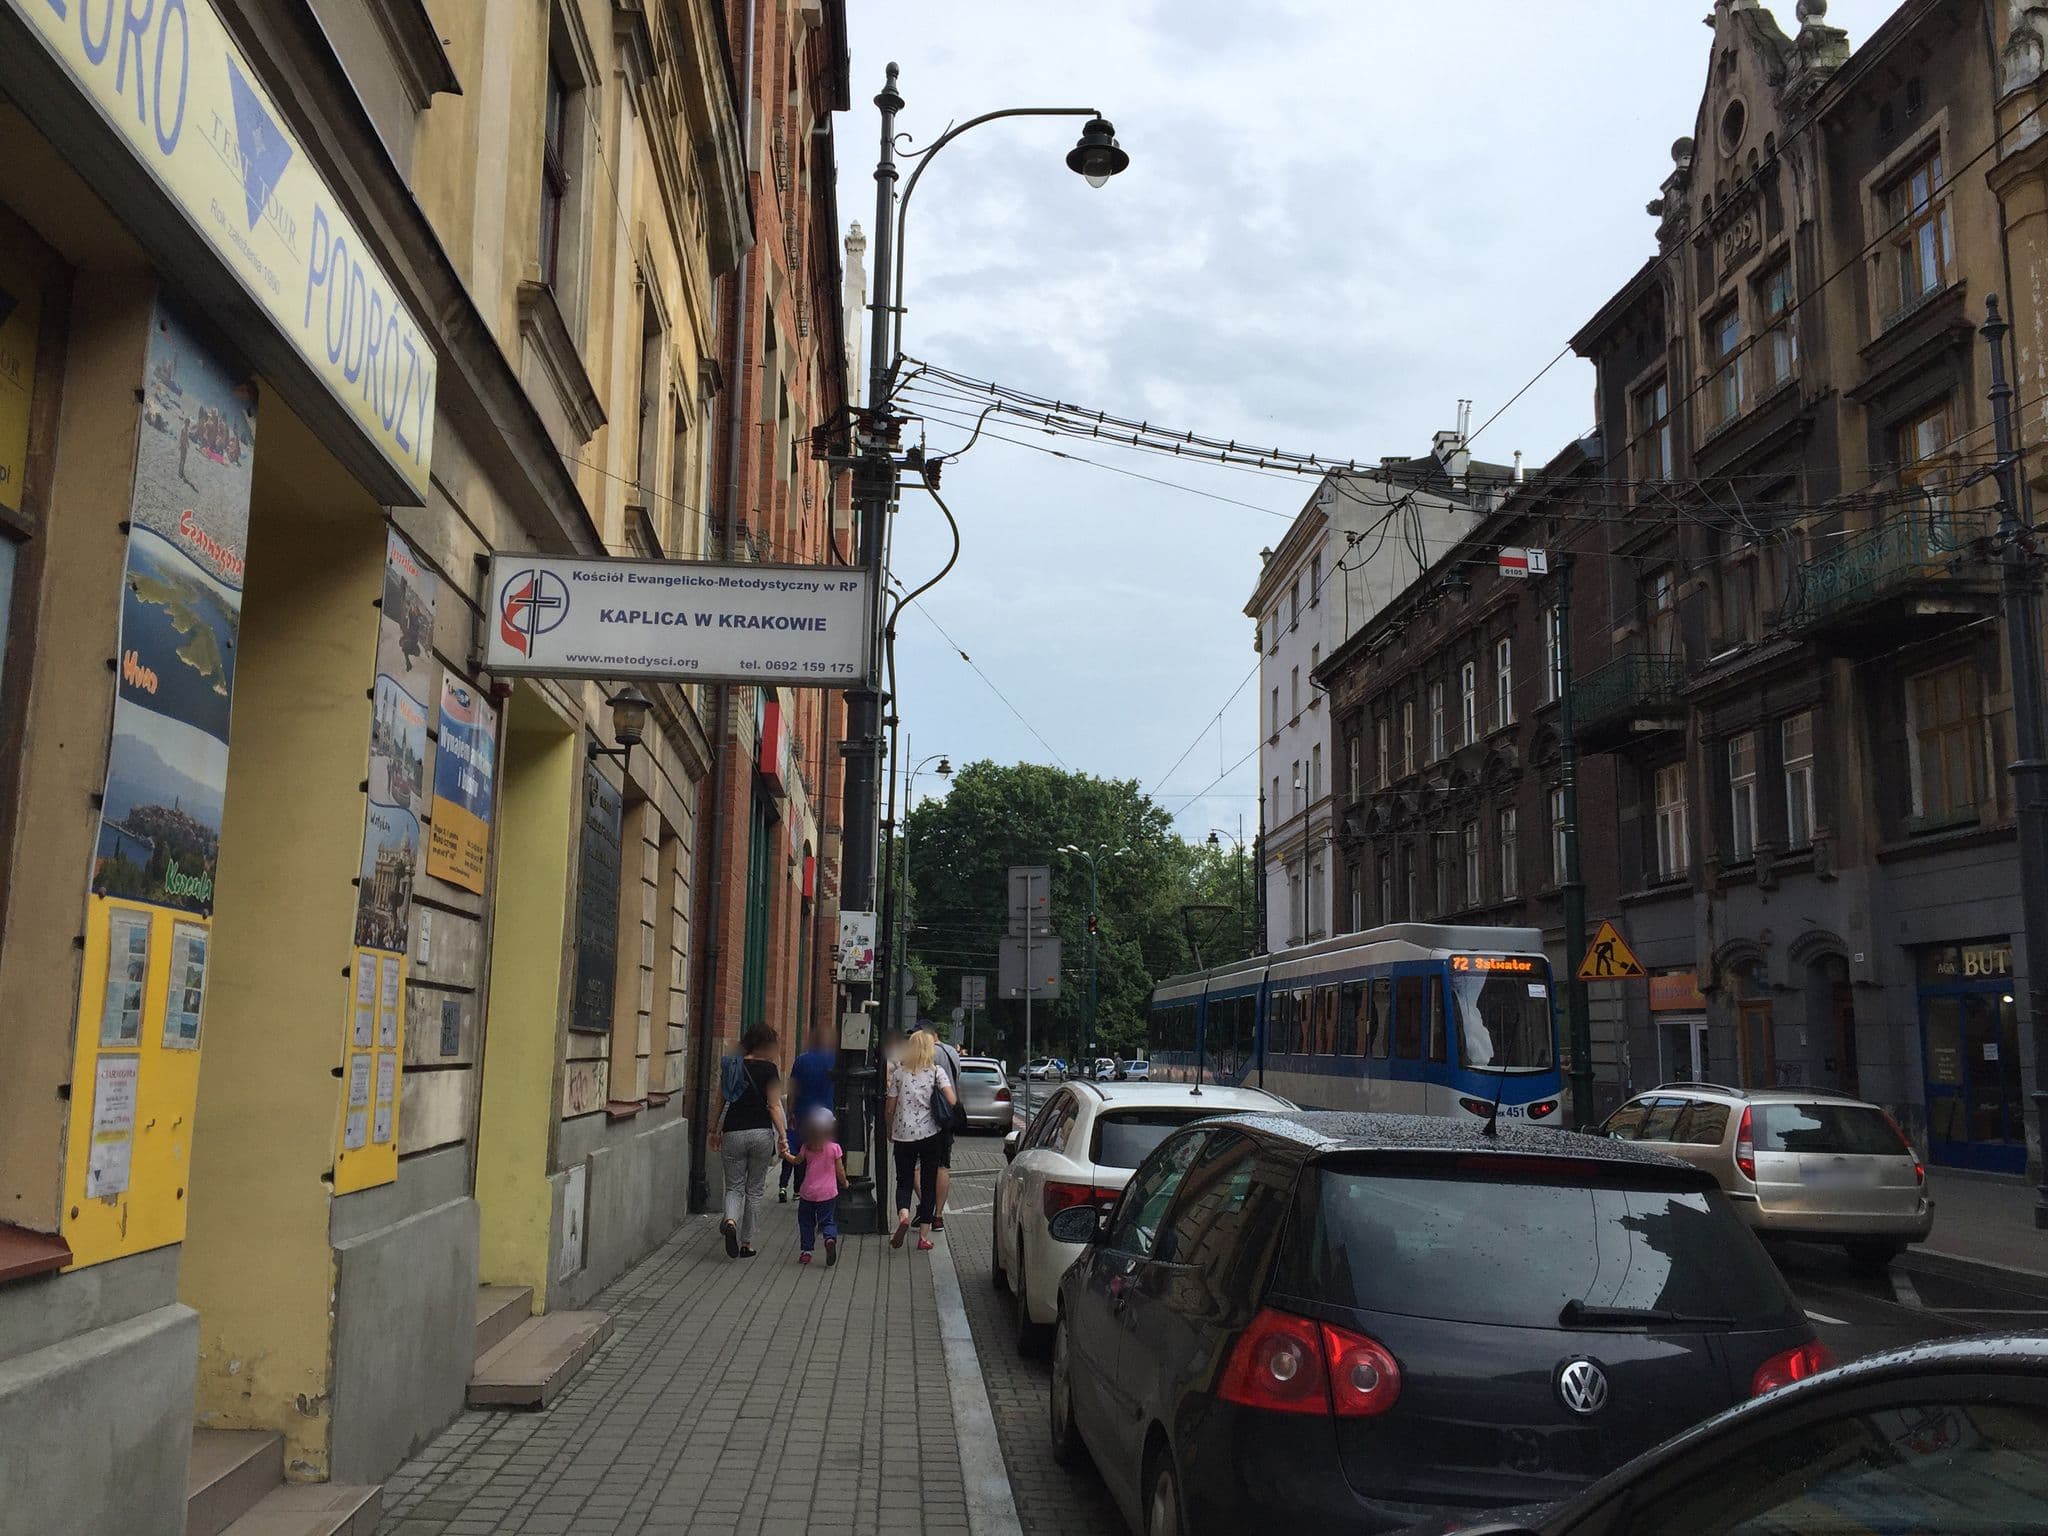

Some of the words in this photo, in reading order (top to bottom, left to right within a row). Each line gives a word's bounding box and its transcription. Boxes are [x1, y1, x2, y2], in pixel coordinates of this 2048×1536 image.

[46, 0, 189, 156] RO
[211, 108, 252, 184] TEST
[258, 174, 298, 251] TOUR
[304, 202, 432, 466] PODRÓŻY
[572, 570, 624, 584] Kościół
[627, 573, 820, 593] Ewangelicko-Metodystyczny
[823, 582, 838, 591] w
[839, 581, 858, 592] RP
[599, 609, 688, 626] KAPLICA
[694, 613, 713, 627] W
[718, 614, 827, 632] KRAKOWIE
[565, 653, 699, 669] www.metodysci.org
[739, 659, 761, 670] tel.
[765, 660, 798, 671] 0692
[802, 661, 826, 672] 159
[829, 662, 855, 673] 175
[1452, 956, 1469, 971] 72
[1964, 949, 2013, 976] BUT
[1506, 1106, 1525, 1118] 451
